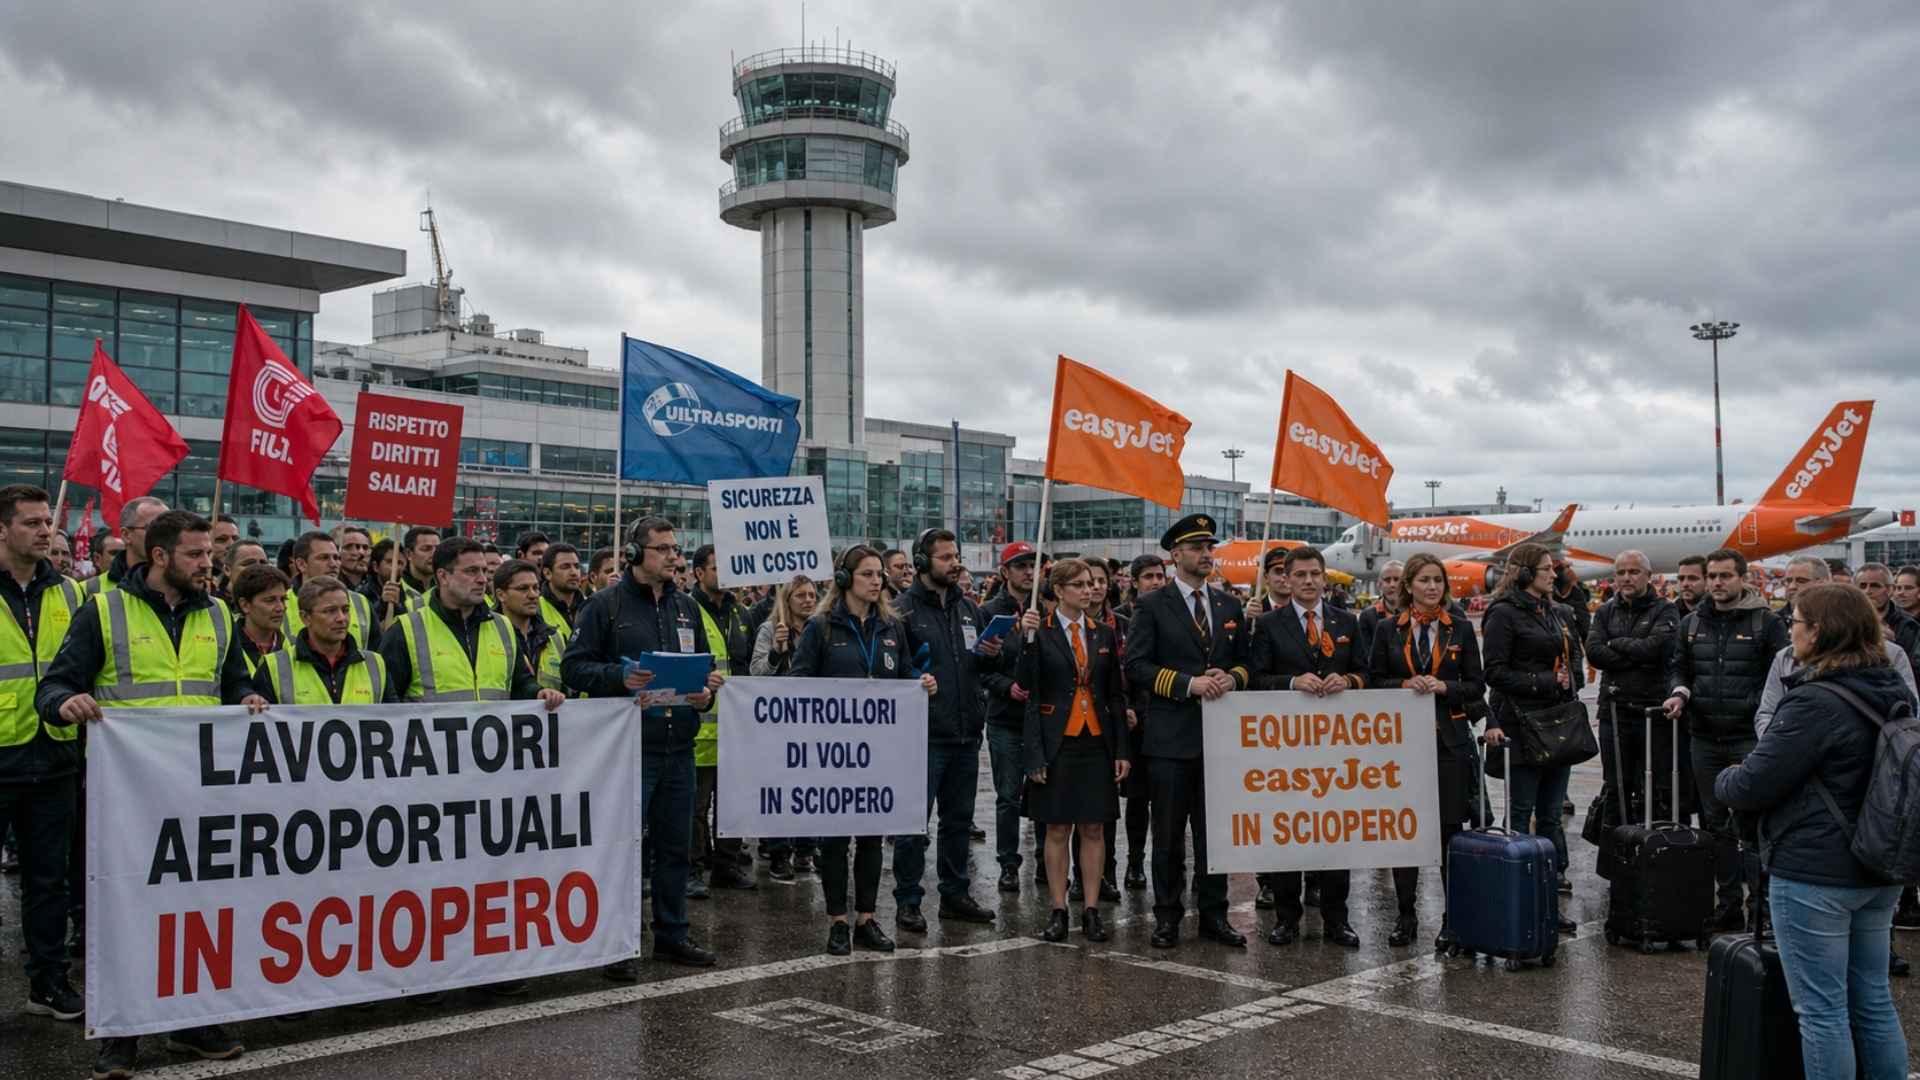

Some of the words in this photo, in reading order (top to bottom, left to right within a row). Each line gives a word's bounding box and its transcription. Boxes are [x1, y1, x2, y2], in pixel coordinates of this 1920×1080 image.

[368, 411, 449, 438] RISPETTO
[665, 405, 784, 434] UILTRASPORTI
[1064, 408, 1175, 457] easyJet
[371, 441, 440, 467] DIRITTI
[1288, 421, 1381, 479] easyJet
[1785, 408, 1863, 499] easyJet
[368, 471, 437, 497] SALARI
[721, 486, 815, 510] SICUREZZA
[745, 519, 781, 541] NON
[788, 514, 799, 538] È
[1397, 522, 1469, 539] easyJet
[731, 554, 756, 575] UN
[763, 550, 818, 572] COSTO
[754, 696, 896, 725] CONTROLLORI
[1240, 712, 1402, 750] EQUIPAGGI
[200, 713, 559, 786] LAVORATORI
[787, 742, 807, 768] DI
[817, 742, 870, 768] VOLO
[1244, 758, 1402, 798] easyJet
[760, 787, 782, 814] IN
[791, 786, 894, 814] SCIOPERO
[147, 791, 592, 885] AEROPORTUALI
[1232, 813, 1261, 846] IN
[1273, 808, 1418, 846] SCIOPERO
[157, 907, 234, 998] IN
[260, 871, 599, 985] SCIOPERO
